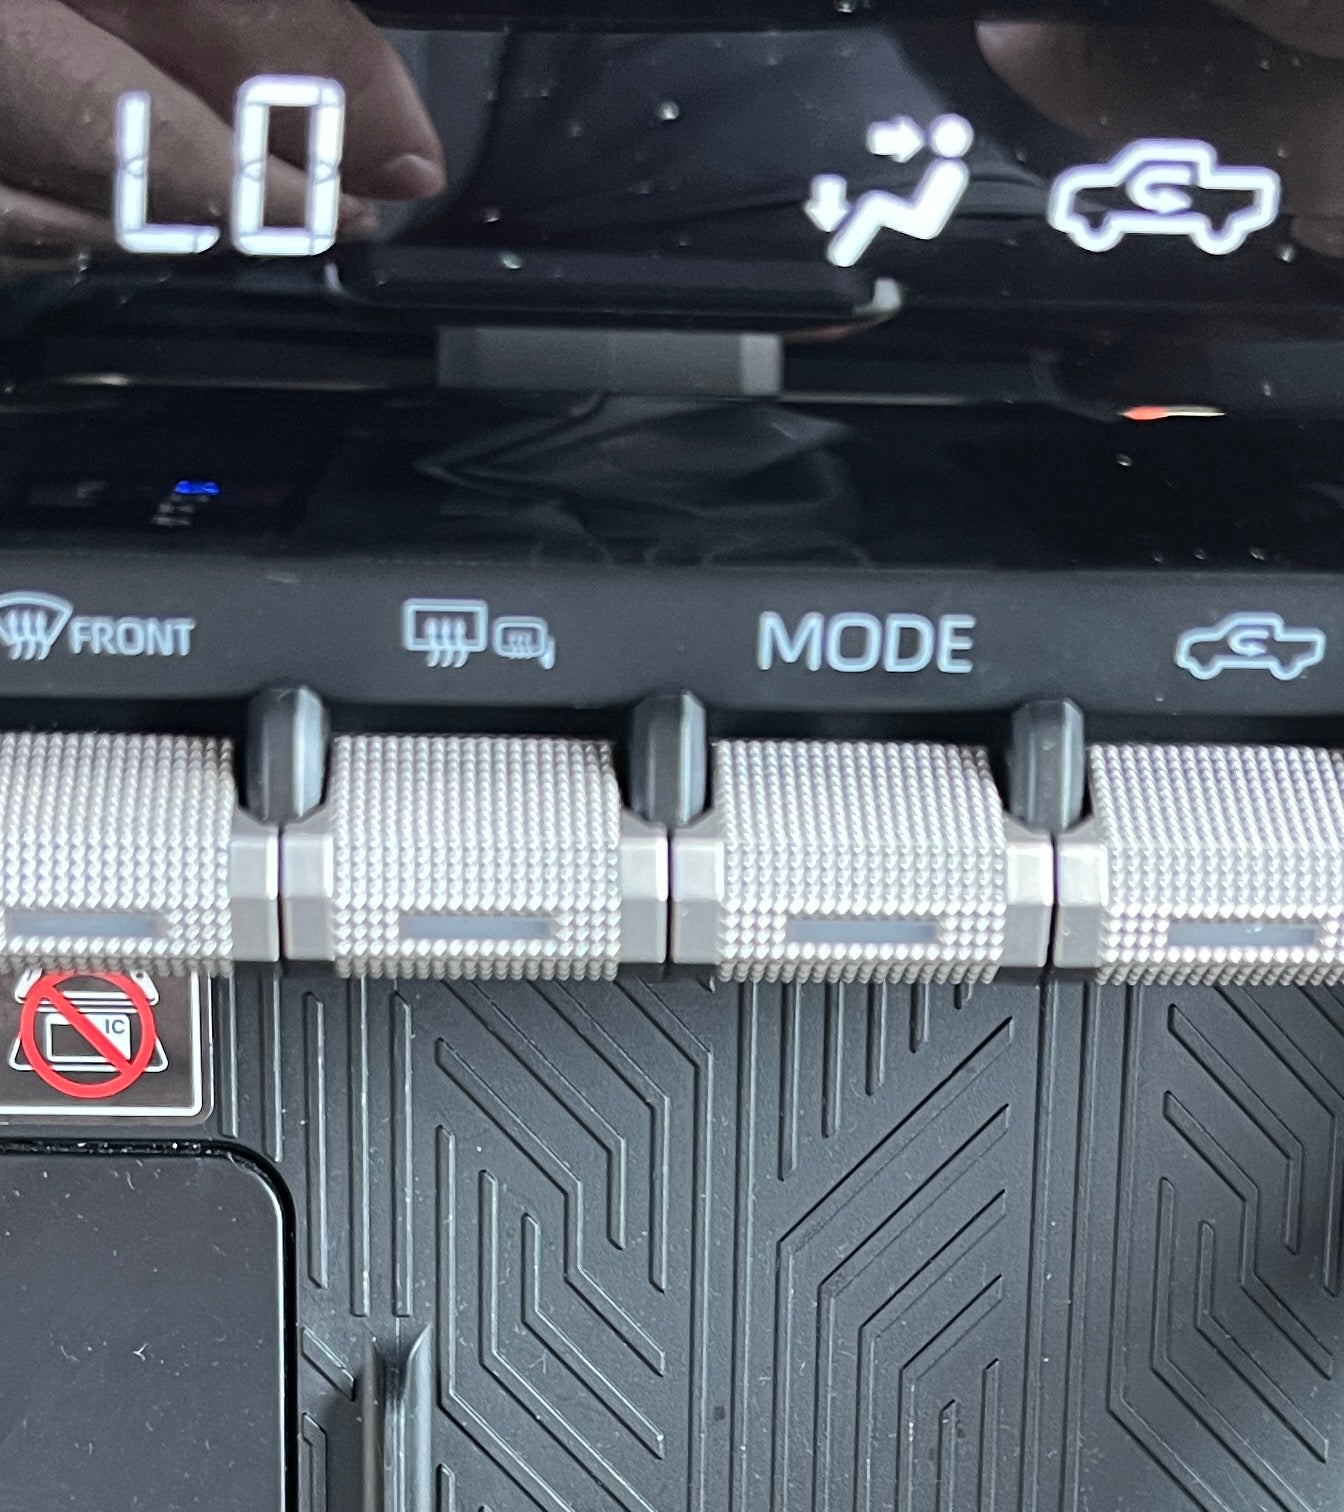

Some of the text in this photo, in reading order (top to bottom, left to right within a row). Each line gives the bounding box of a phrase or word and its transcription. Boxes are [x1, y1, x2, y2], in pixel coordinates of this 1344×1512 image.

[69, 616, 195, 656] FRONT
[758, 611, 976, 673] MODE
[105, 1018, 125, 1035] IC
